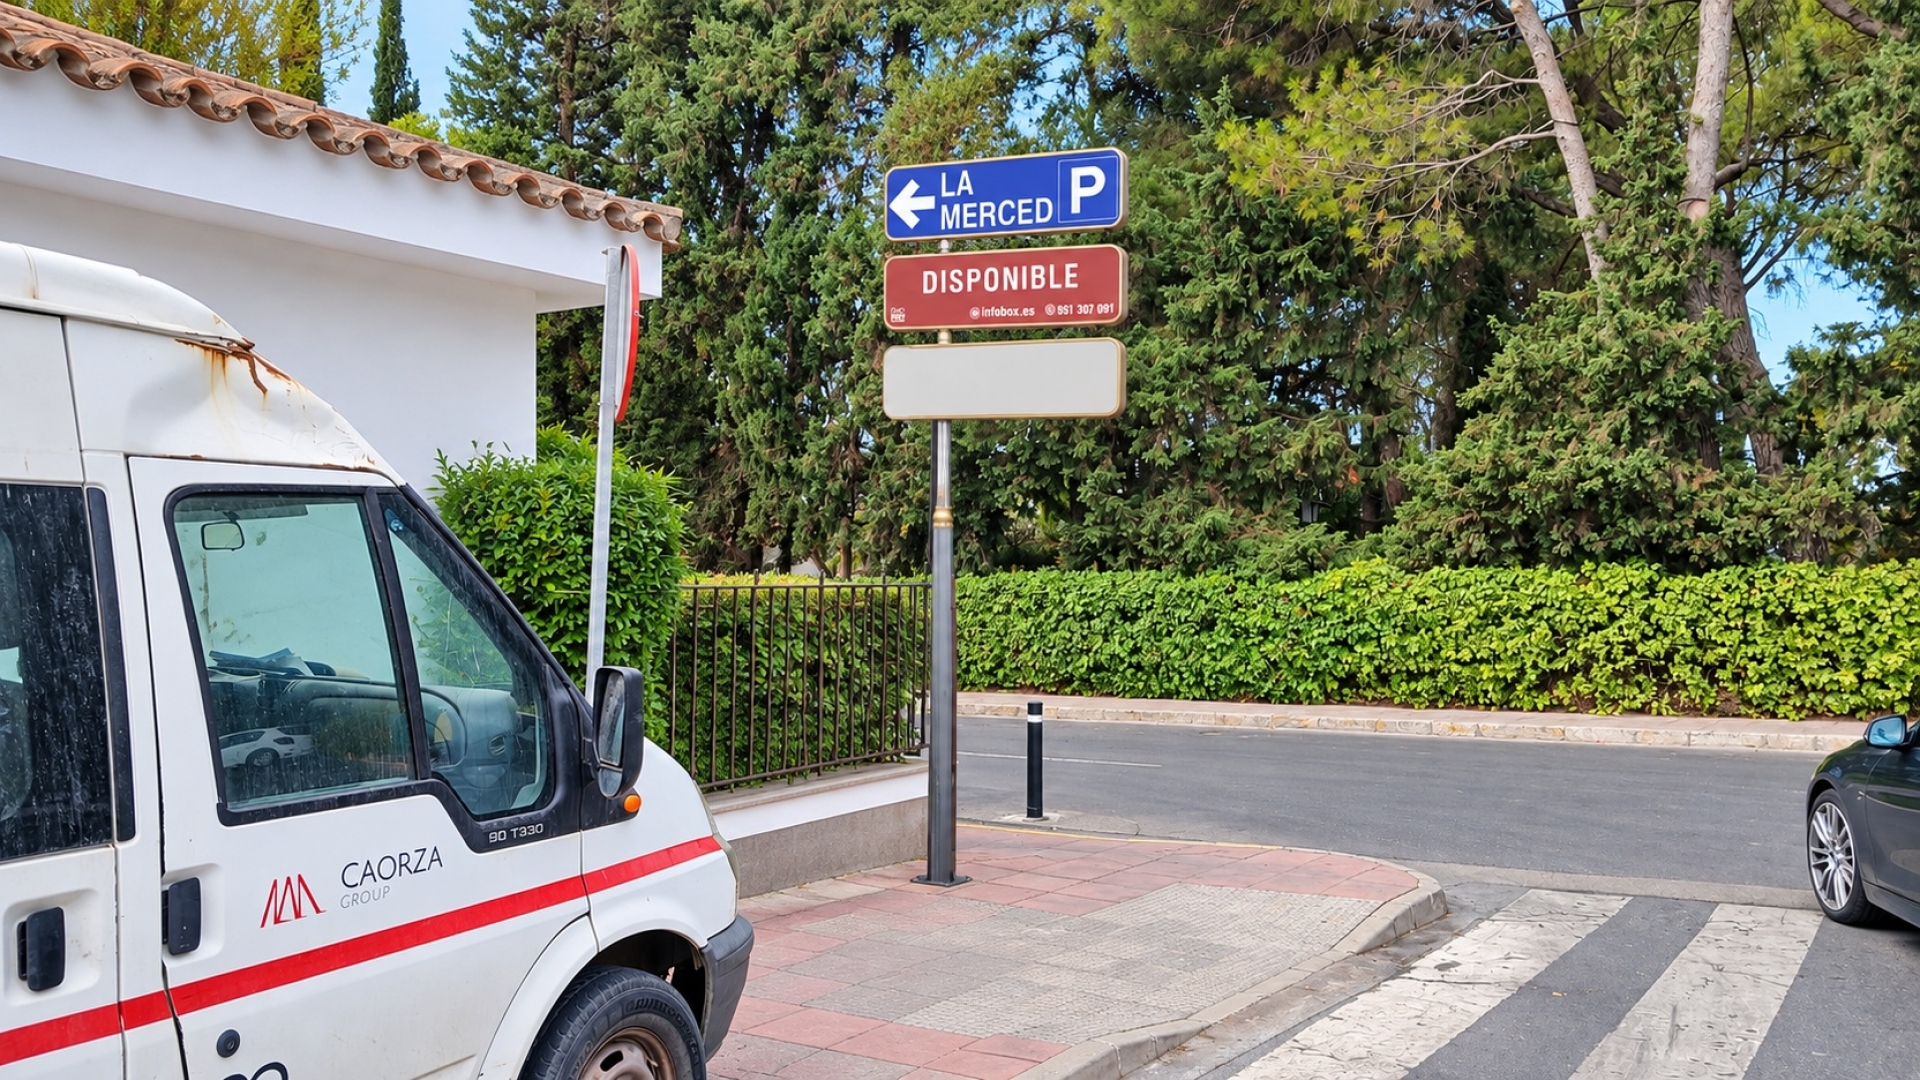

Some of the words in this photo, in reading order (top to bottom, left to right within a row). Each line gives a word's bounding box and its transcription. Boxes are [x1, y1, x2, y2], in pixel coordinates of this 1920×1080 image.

[941, 170, 974, 198] LA
[1070, 165, 1106, 214] P
[940, 197, 1053, 231] MERCED
[922, 263, 1079, 294] DISPONIBLE
[1077, 303, 1094, 315] 307
[488, 830, 507, 844] 90
[510, 823, 544, 839] T330
[340, 845, 443, 888] CAORZA
[339, 885, 391, 909] GROUP
